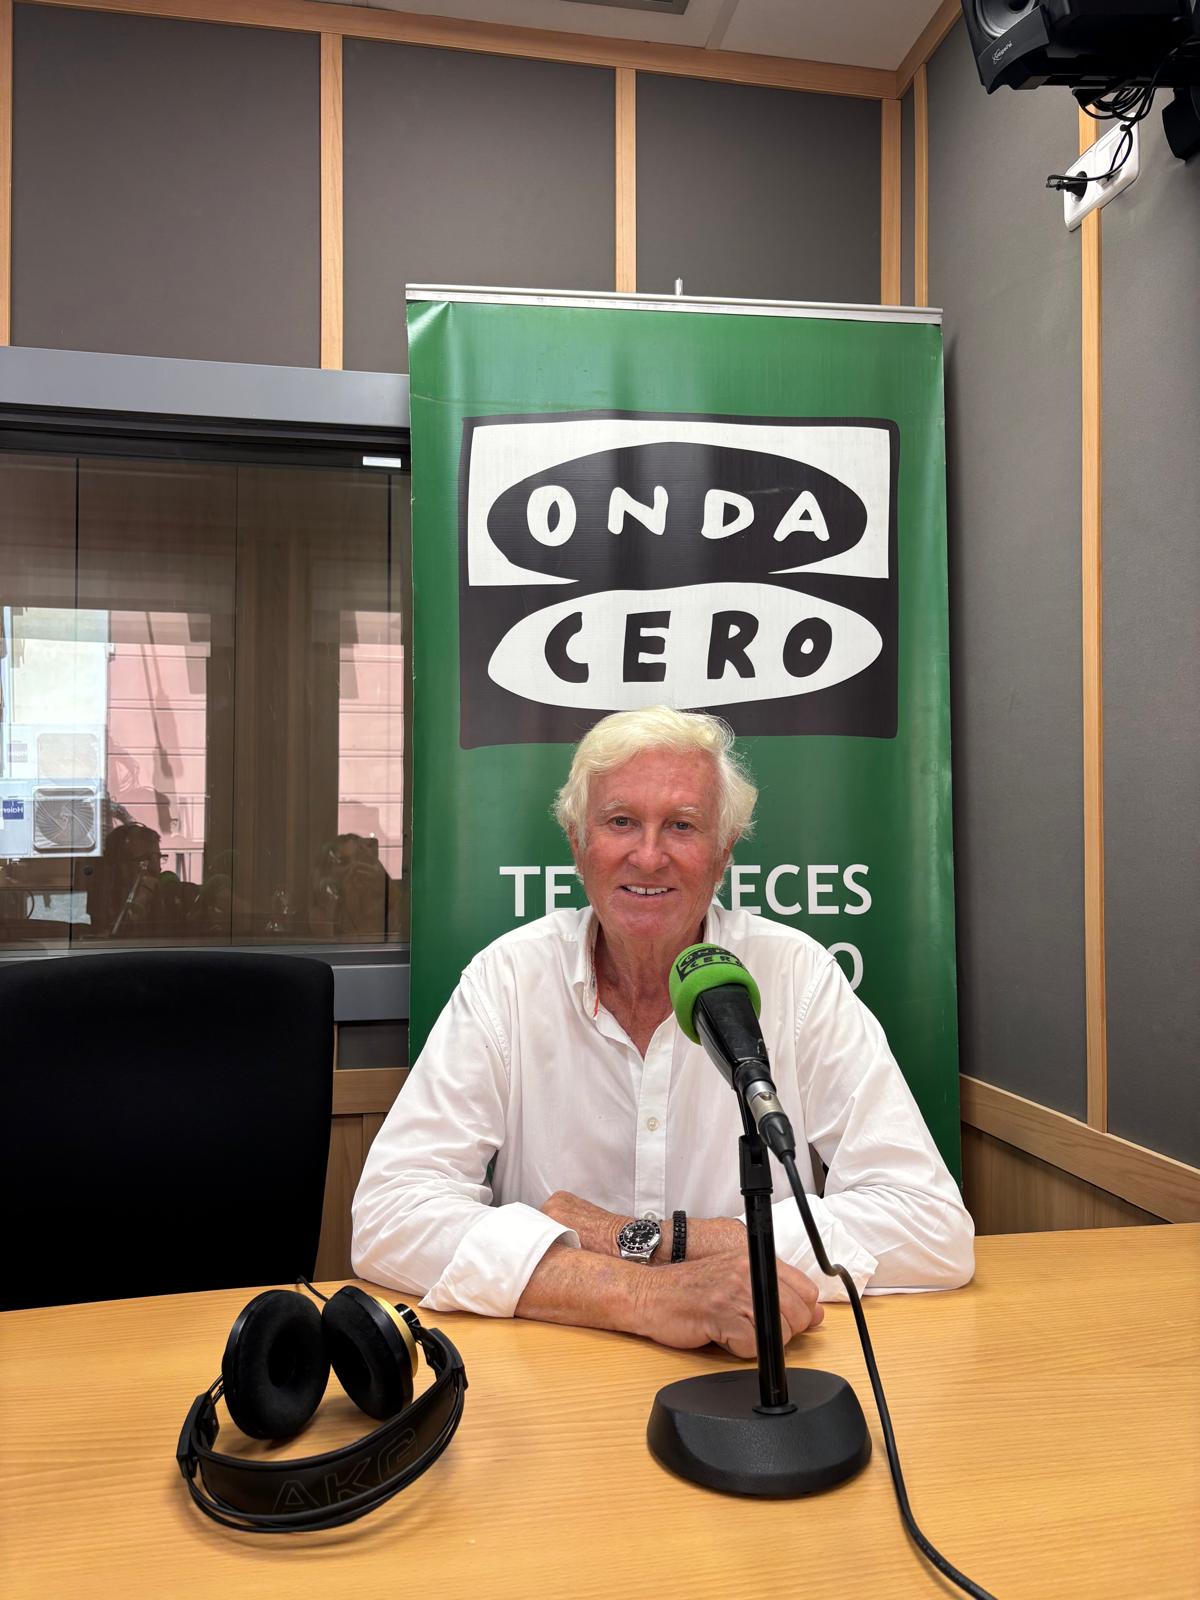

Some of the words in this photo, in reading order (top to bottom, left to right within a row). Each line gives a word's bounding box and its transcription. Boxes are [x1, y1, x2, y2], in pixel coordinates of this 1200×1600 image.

[526, 484, 830, 547] ONDA
[544, 610, 833, 683] CERO
[713, 864, 873, 916] ECES
[271, 1427, 419, 1514] AKG
